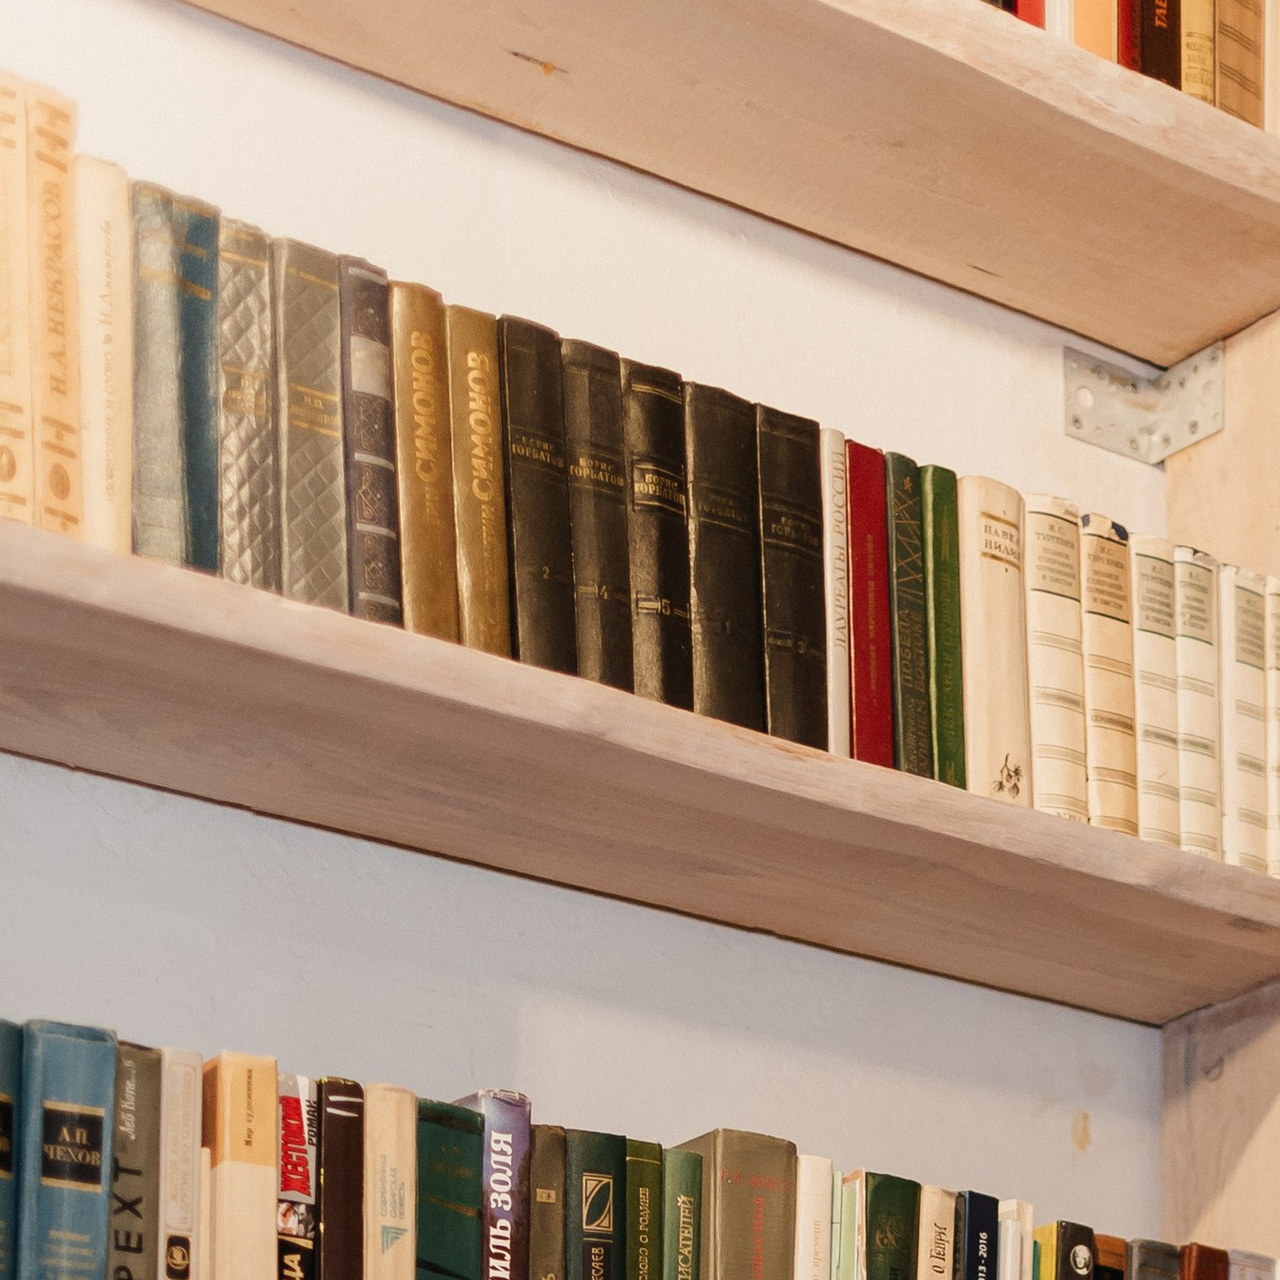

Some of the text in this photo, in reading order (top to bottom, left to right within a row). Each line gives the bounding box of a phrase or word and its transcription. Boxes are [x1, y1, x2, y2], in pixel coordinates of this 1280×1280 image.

[411, 331, 438, 482] СИМОНОВ
[467, 351, 495, 501] СИМОНОВ
[832, 451, 847, 653] ЛАУРЕАТЫ РОССИИ
[279, 1095, 311, 1197] ЖЕСТОКИЙ
[489, 1131, 513, 1212] ЗОЛЯ
[639, 1187, 650, 1232] РОДИНЕ
[978, 1232, 988, 1257] 2016
